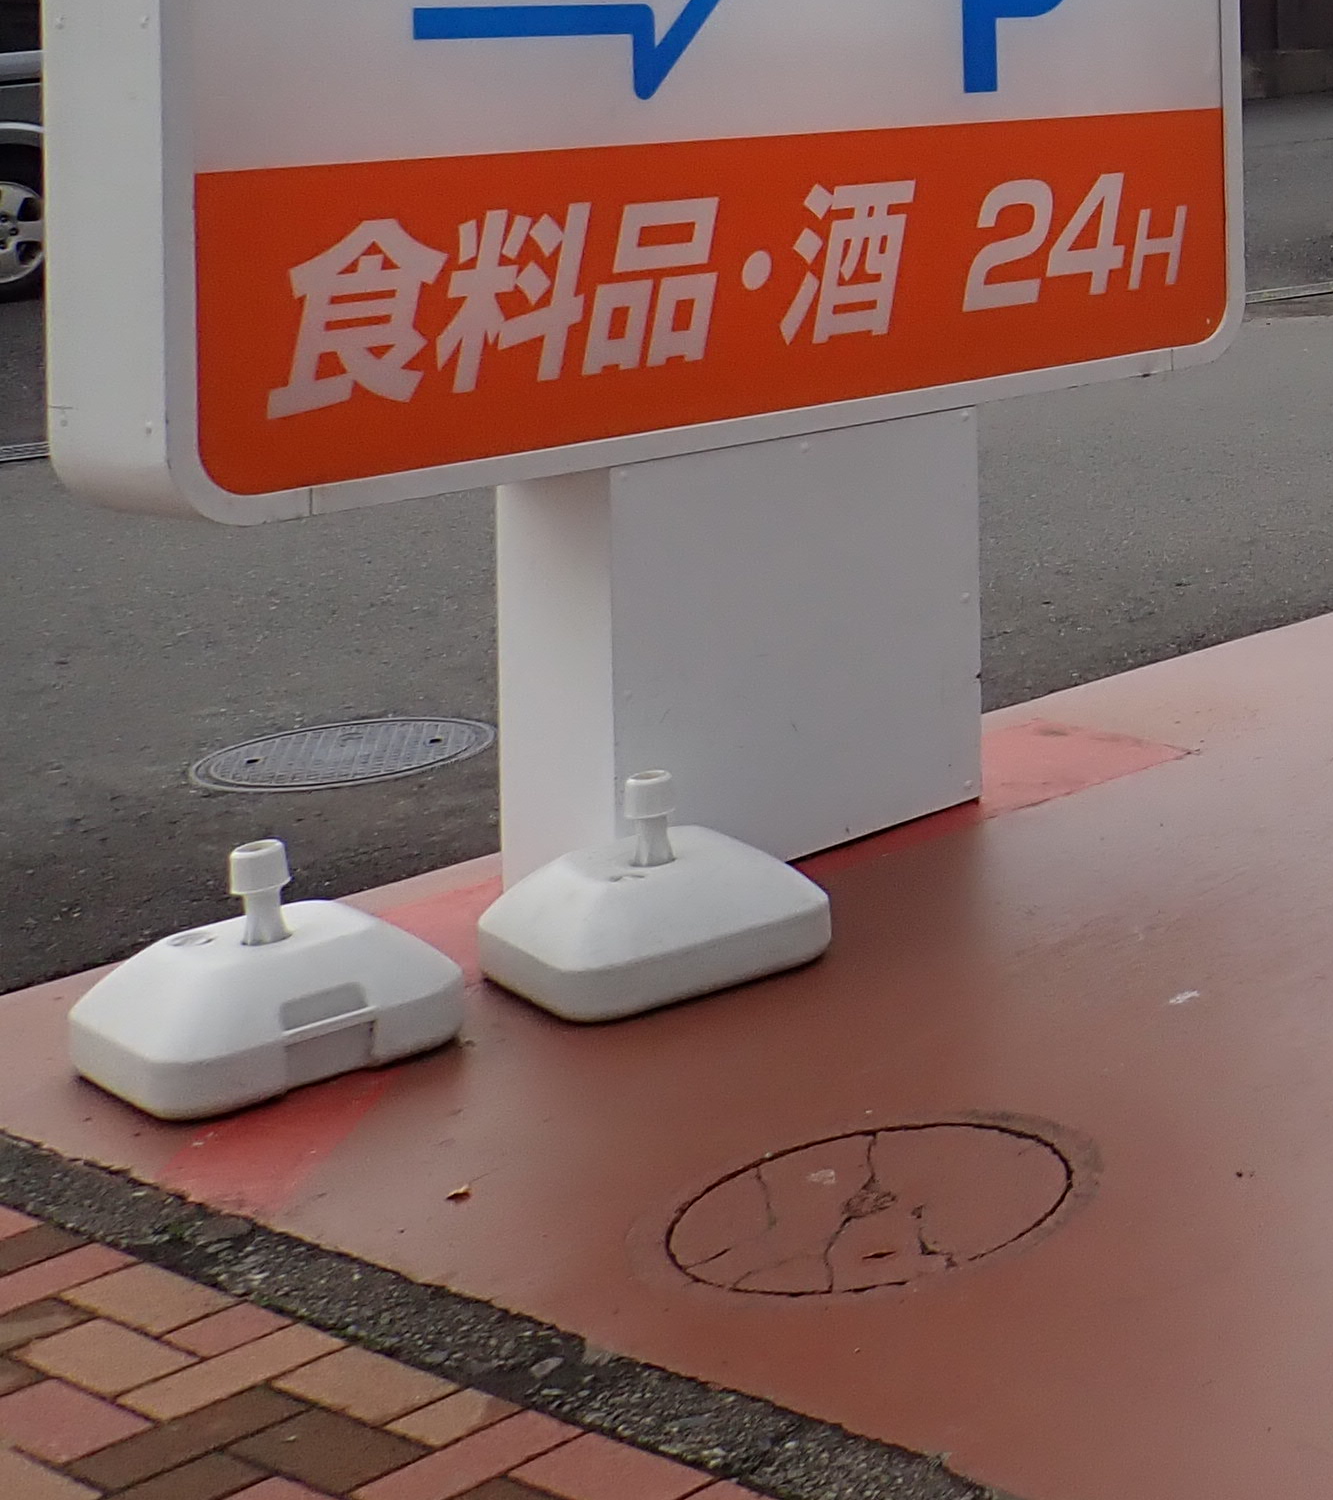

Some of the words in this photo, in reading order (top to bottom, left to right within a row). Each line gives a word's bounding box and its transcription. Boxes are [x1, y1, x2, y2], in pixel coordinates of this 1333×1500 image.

[267, 180, 915, 419] 食料品・酒
[963, 171, 1187, 313] 24H
